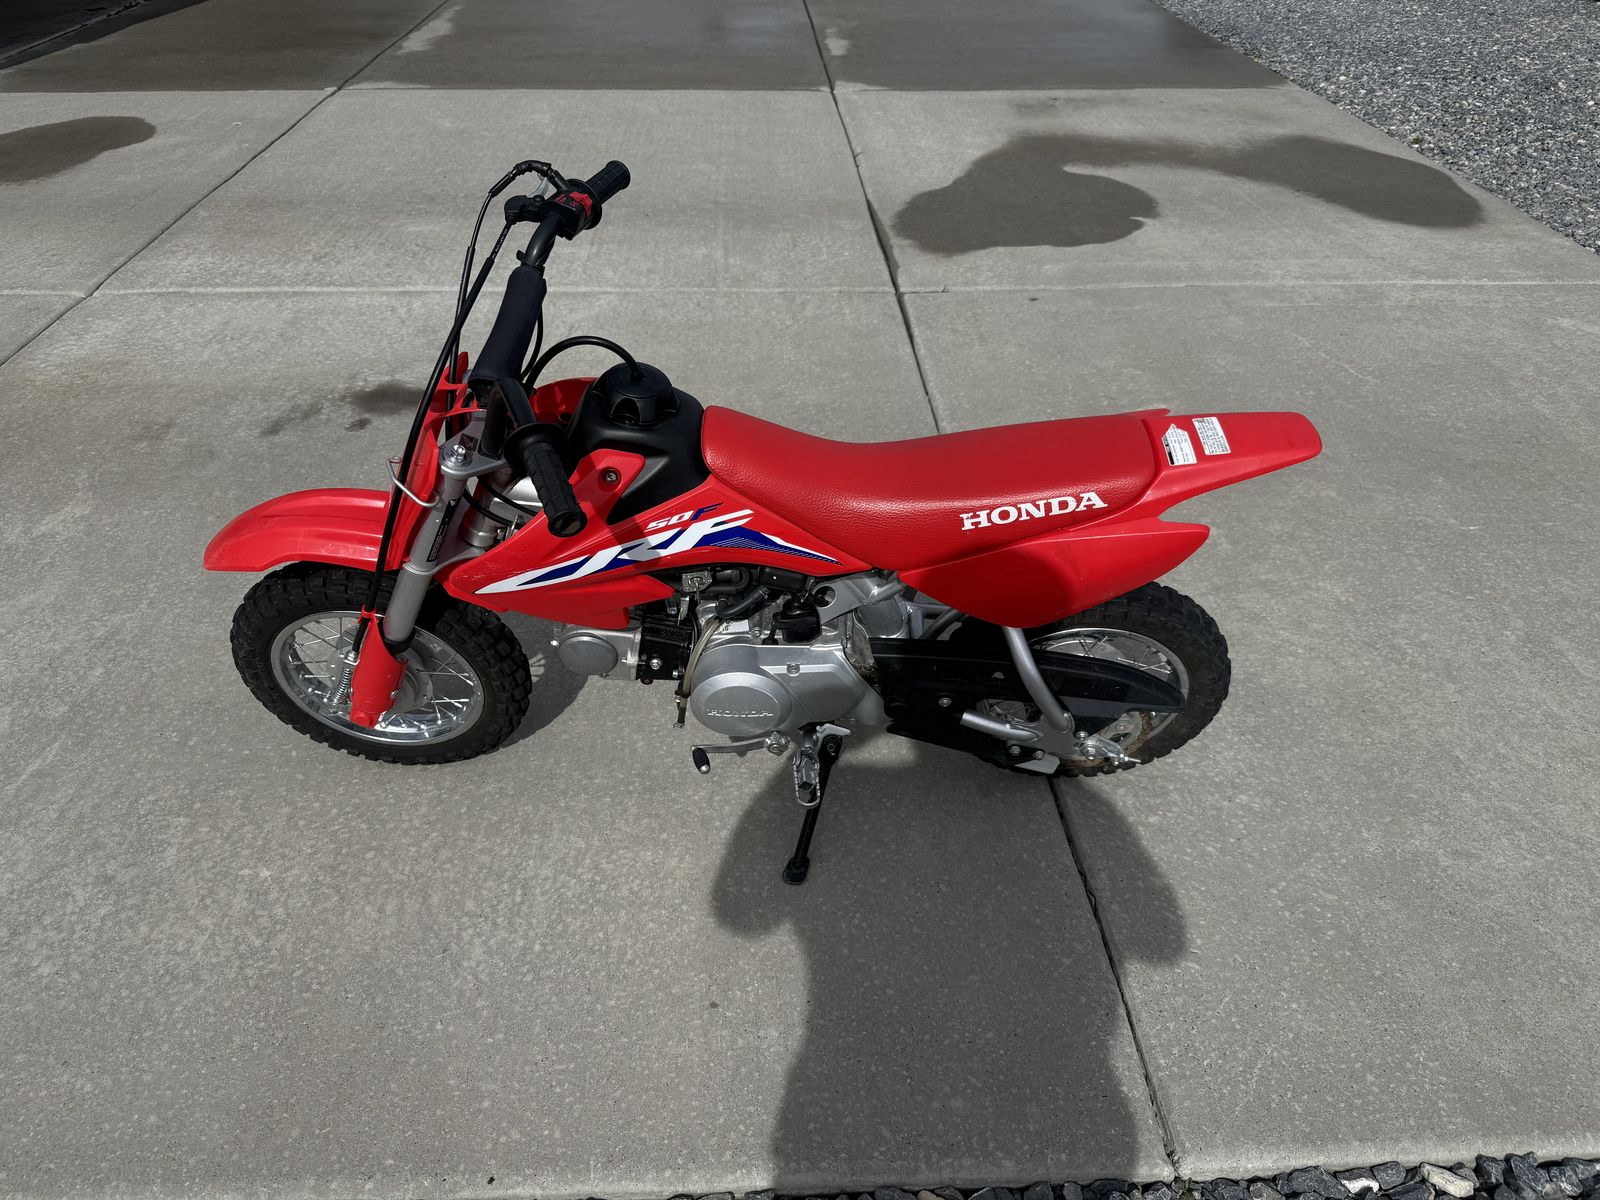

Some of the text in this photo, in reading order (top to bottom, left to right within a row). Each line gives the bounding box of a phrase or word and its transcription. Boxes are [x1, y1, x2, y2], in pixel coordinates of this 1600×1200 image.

[643, 502, 724, 532] 50F
[959, 491, 1108, 531] HONDA
[706, 703, 775, 718] HONDA
